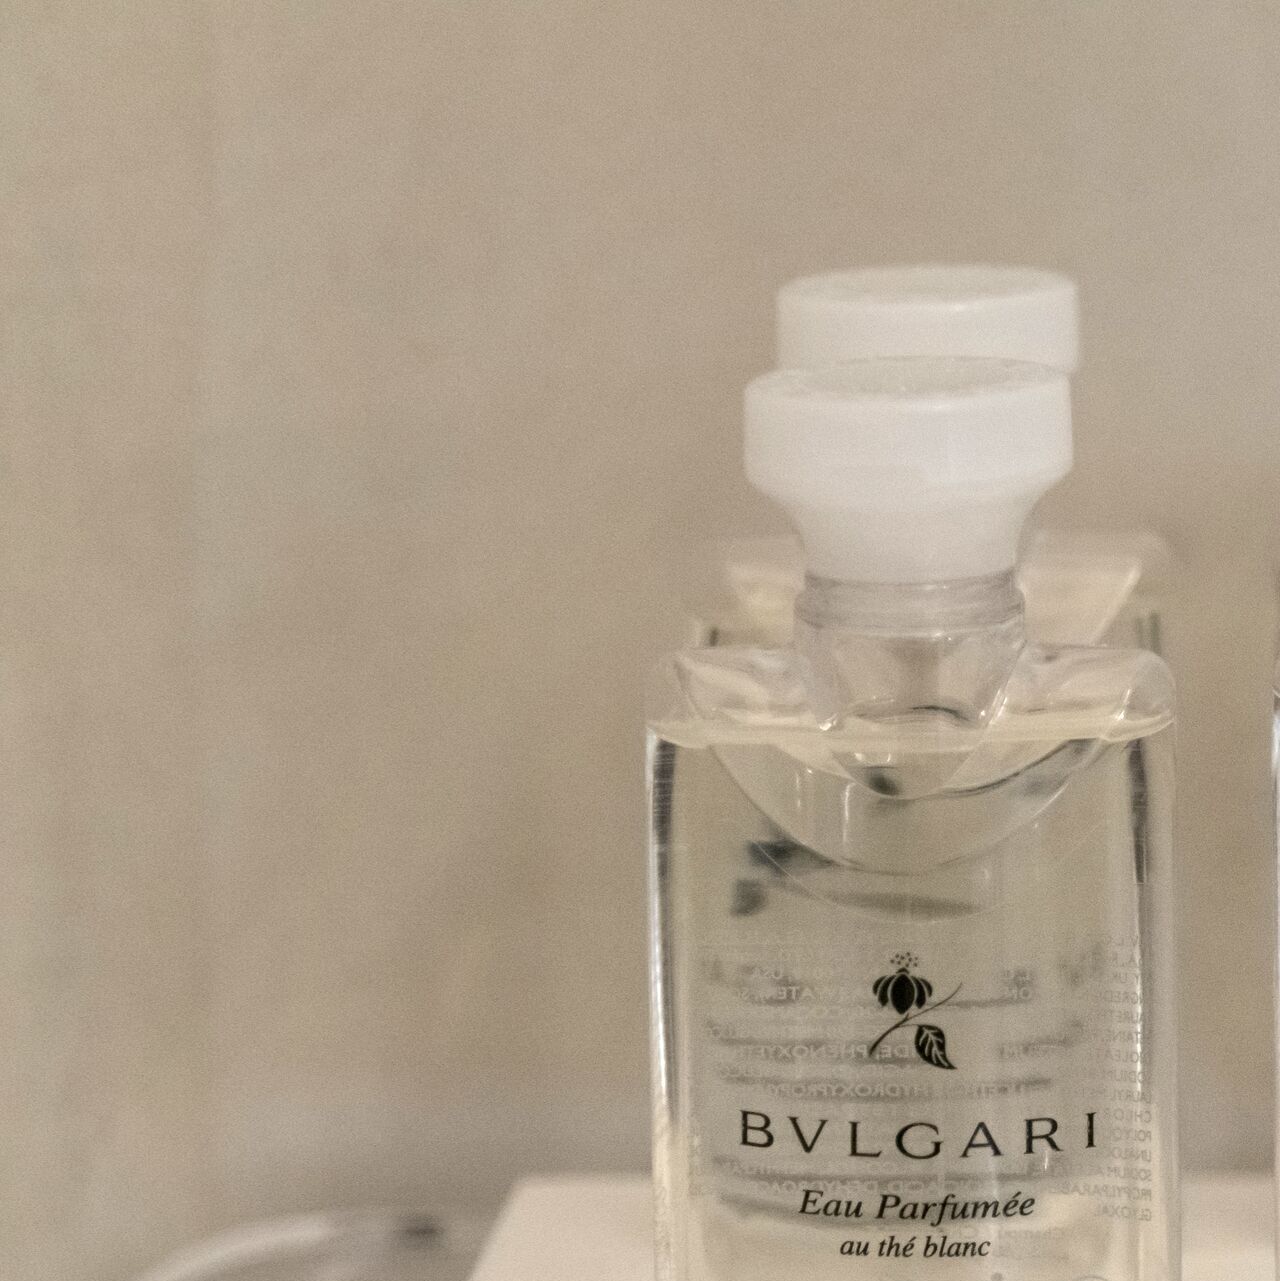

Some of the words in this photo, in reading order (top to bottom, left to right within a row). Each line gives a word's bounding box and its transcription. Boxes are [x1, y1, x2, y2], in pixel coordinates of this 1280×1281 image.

[741, 1110, 1095, 1160] BVLGARI
[799, 1189, 863, 1219] Eau
[875, 1191, 1035, 1227] Parfumée
[839, 1240, 870, 1256] au
[878, 1235, 915, 1258] thé
[922, 1235, 990, 1258] blanc
